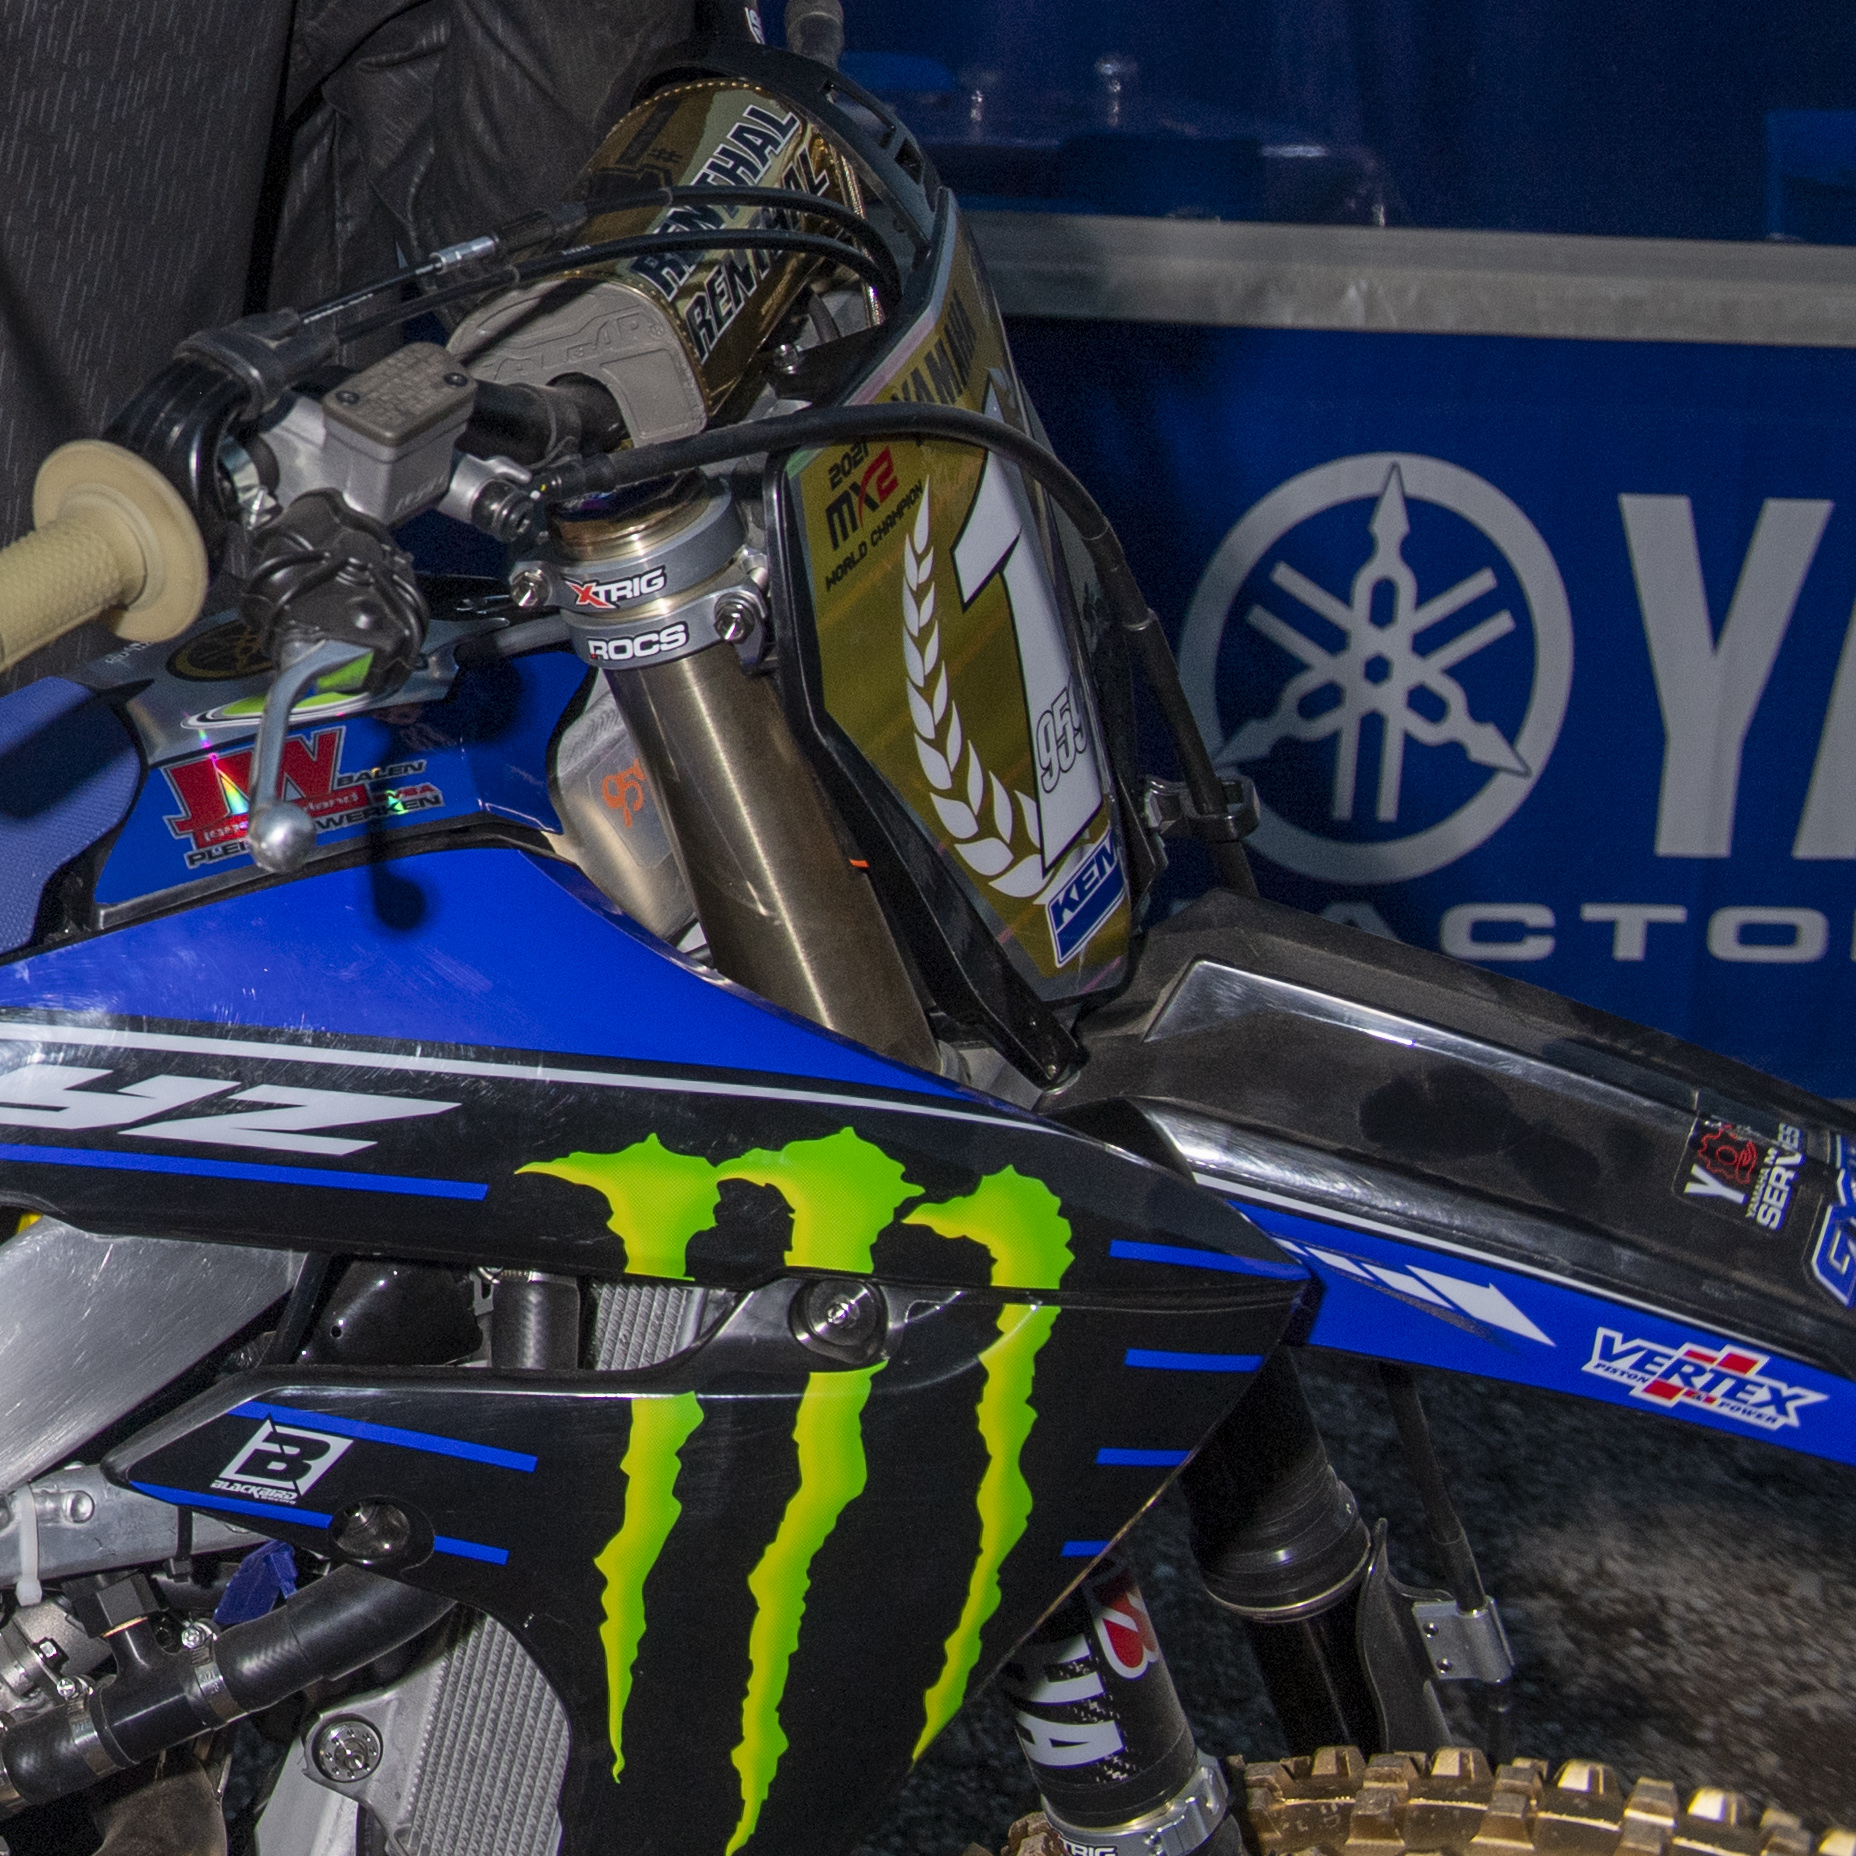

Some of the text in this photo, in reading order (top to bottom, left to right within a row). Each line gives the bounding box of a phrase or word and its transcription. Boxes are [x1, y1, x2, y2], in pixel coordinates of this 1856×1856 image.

[828, 442, 870, 491] 2021
[826, 447, 899, 552] MX2
[825, 479, 924, 592] WORLD CHAMPION
[568, 568, 666, 609] XTRIG
[589, 624, 687, 661] ROCS
[336, 760, 427, 786] BALEN
[1593, 1361, 1650, 1385] PISTON
[1718, 1399, 1779, 1425] POWER
[1597, 1330, 1811, 1420] VERTEX
[210, 1479, 298, 1500] BLACKBIRD
